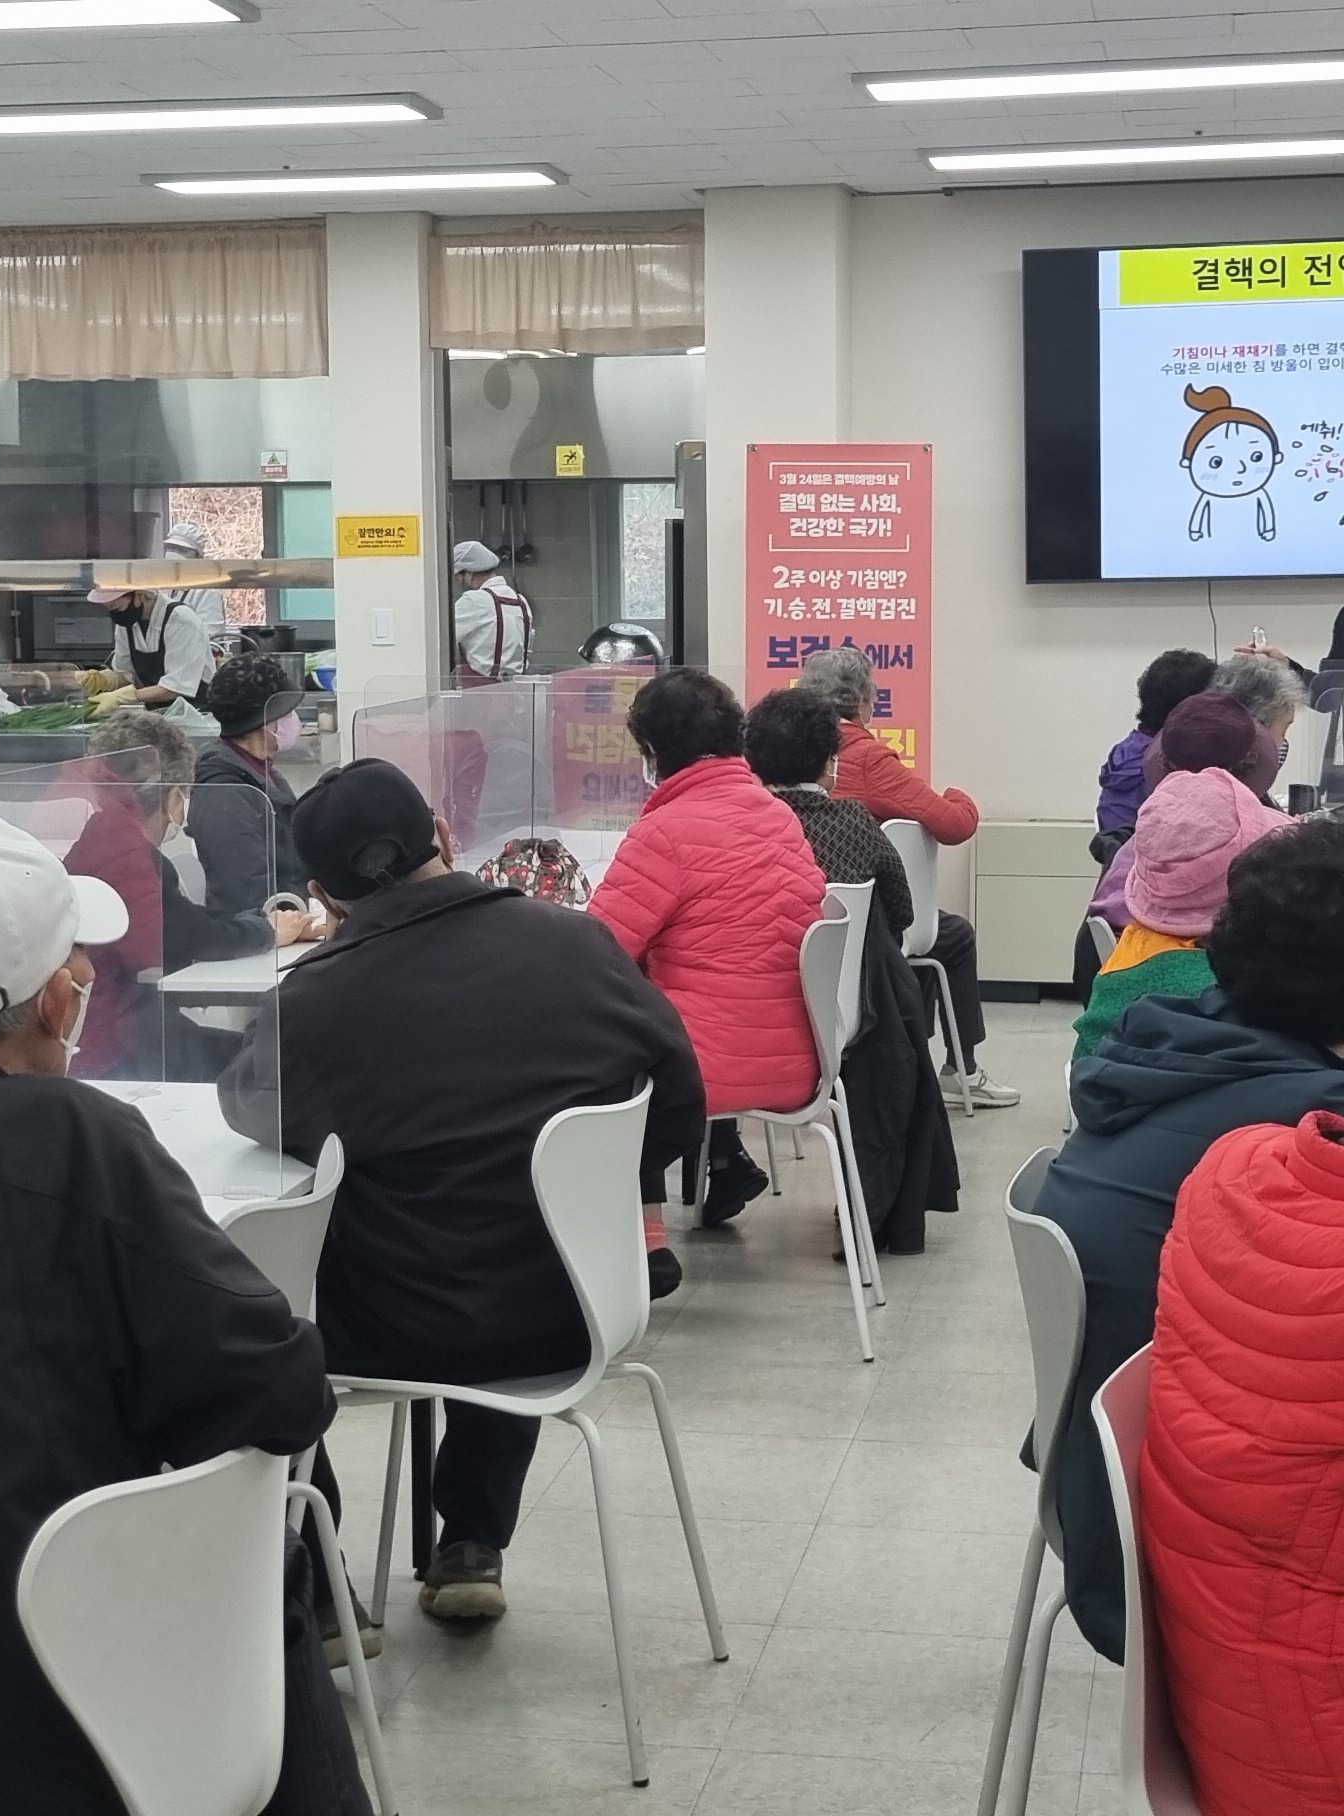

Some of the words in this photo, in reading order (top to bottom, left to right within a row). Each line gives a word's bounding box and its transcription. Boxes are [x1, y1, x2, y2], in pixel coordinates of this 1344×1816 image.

[1192, 255, 1286, 291] 결핵의
[1172, 345, 1227, 360] 기침이나
[1232, 343, 1288, 358] 재채기를
[1292, 342, 1320, 356] 하면
[1160, 361, 1201, 376] 수많은
[1206, 360, 1247, 374] 미세한
[1253, 359, 1266, 373] 침
[1270, 358, 1312, 372] 방울이
[1300, 419, 1344, 441] 에취!
[779, 473, 797, 485] 3월
[779, 493, 816, 513] 결핵
[819, 493, 856, 513] 없는
[859, 493, 902, 514] 사회,
[789, 517, 846, 537] 건강한
[849, 517, 892, 538] 국가!
[772, 565, 806, 589] 2주
[808, 568, 843, 590] 이상
[846, 568, 907, 590] 기침엔?
[763, 597, 917, 621] 기.승.전.결핵검진
